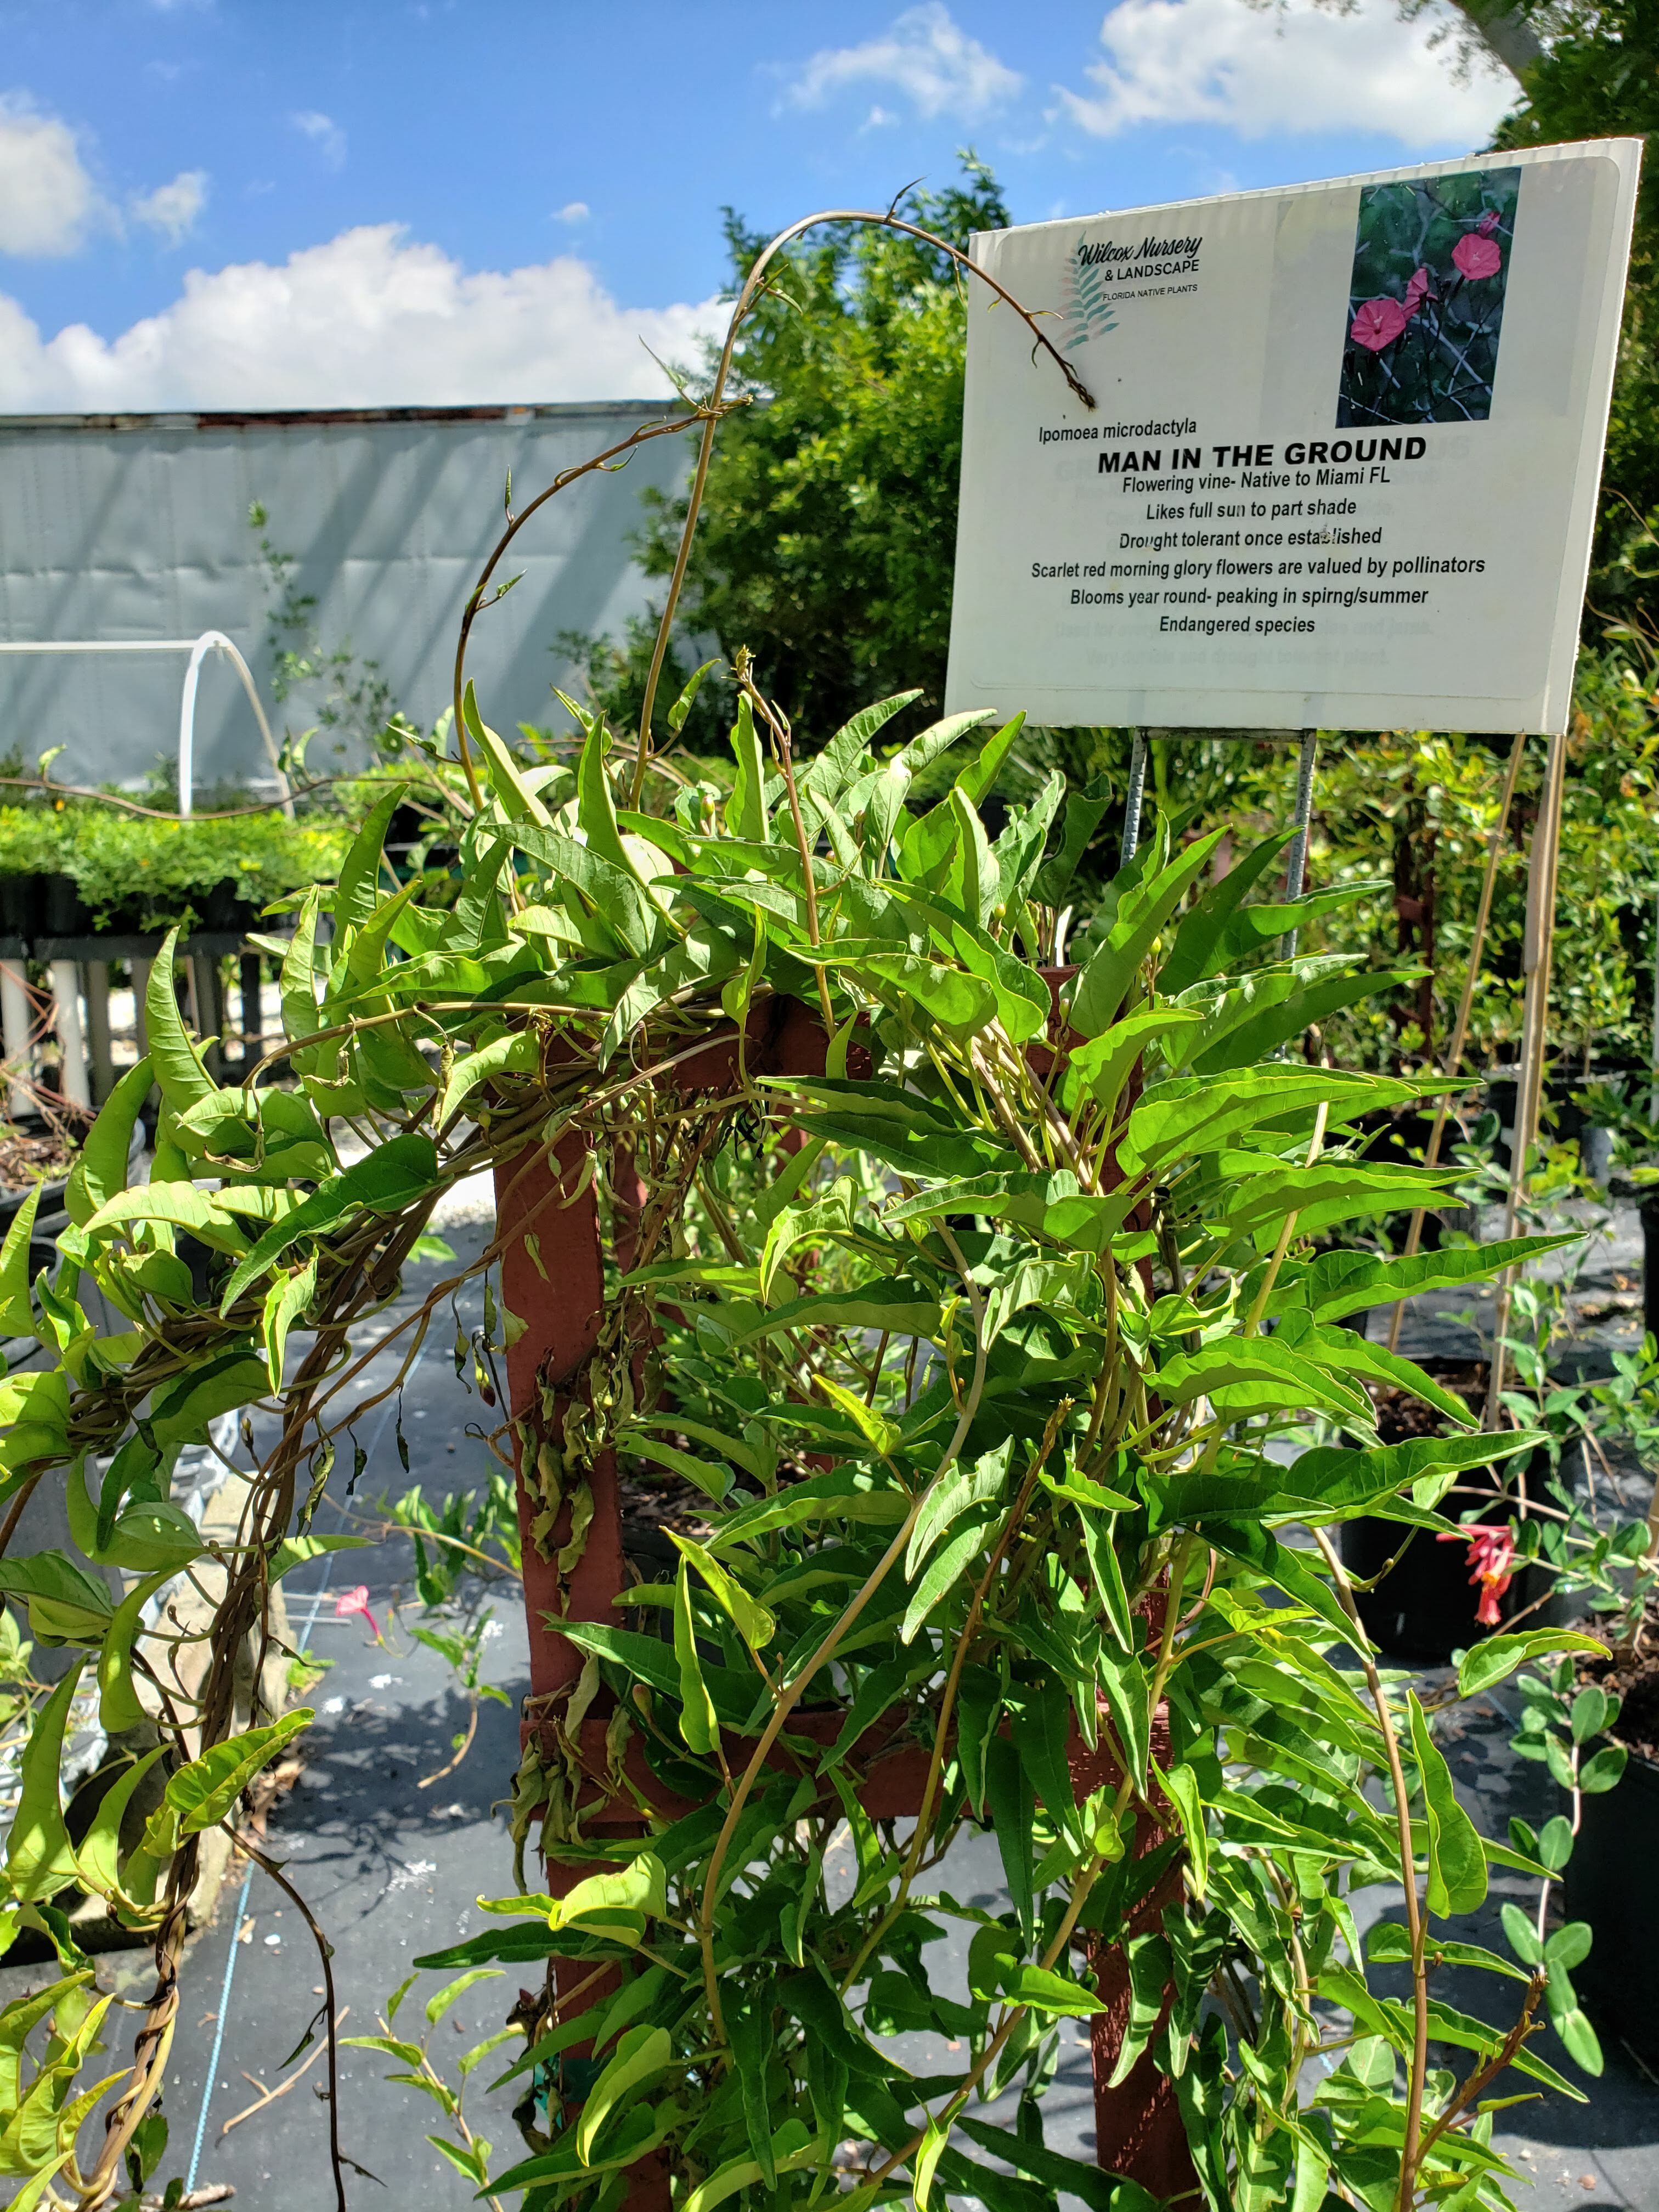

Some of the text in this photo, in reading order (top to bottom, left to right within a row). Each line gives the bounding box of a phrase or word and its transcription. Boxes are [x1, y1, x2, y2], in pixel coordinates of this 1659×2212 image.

[1077, 236, 1203, 267] Wilcox Nursery
[1104, 259, 1200, 281] & LANDSCAPE
[1102, 284, 1198, 301] FLORIDA NATIVE PLANTS
[1039, 417, 1197, 445] Ipomoea microdactyla
[1098, 449, 1162, 474] MAN
[1171, 447, 1201, 470] IN
[1212, 444, 1274, 468] THE
[1284, 436, 1426, 465] GROUND
[1122, 475, 1194, 494] Flowering
[1198, 472, 1236, 489] vine-
[1240, 471, 1290, 488] Native
[1295, 470, 1311, 487] to
[1316, 466, 1365, 486] Miami
[1369, 466, 1391, 484] FL
[1146, 503, 1185, 520] Likes
[1189, 501, 1213, 518] full
[1216, 505, 1245, 518] sun
[1250, 501, 1267, 517] to
[1271, 500, 1304, 521] part
[1307, 498, 1357, 516] shade
[1119, 531, 1178, 552] Drought
[1181, 531, 1241, 547] tolerant
[1244, 533, 1283, 546] once
[1031, 556, 1486, 580] Scarlet red morning glory flowers are valued by pollinators
[1070, 586, 1429, 608] Blooms year round- peaking in spirng/summer
[1159, 616, 1251, 636] Endangered
[1254, 616, 1316, 636] species
